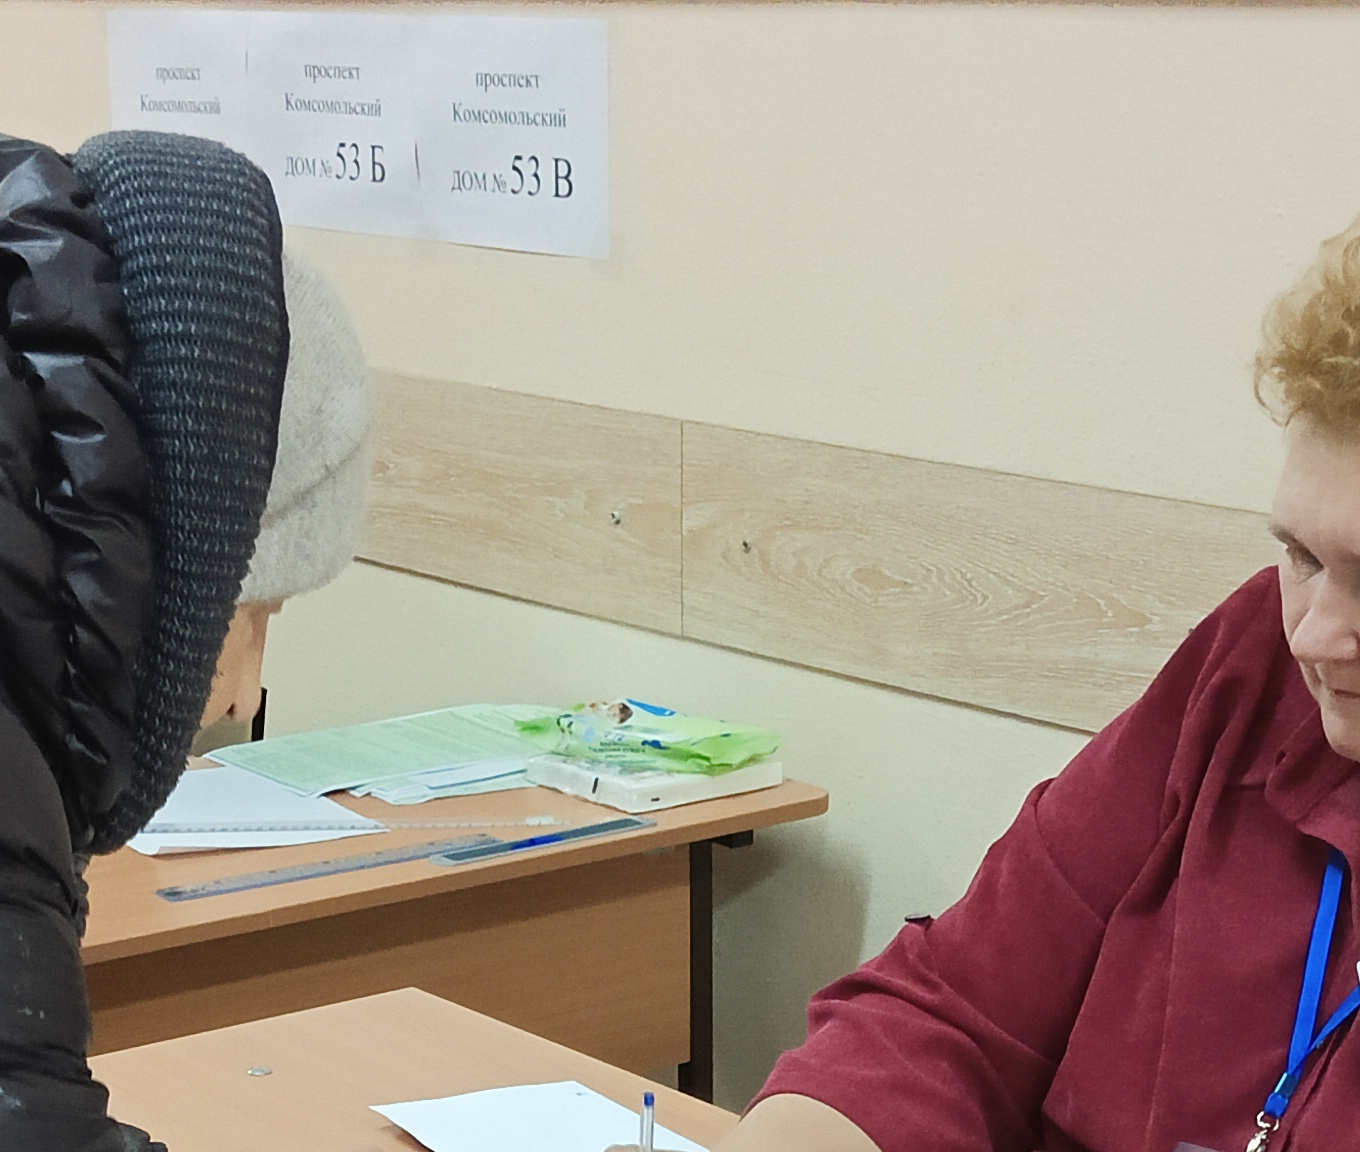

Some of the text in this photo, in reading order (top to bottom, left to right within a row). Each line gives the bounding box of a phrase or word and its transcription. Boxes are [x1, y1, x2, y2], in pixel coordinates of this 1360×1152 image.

[304, 64, 361, 84] проспект
[475, 71, 540, 93] проспект
[284, 92, 382, 118] Комсомольский
[452, 101, 568, 129] Комсомольский
[334, 142, 362, 182] 53
[369, 144, 386, 184] Б
[510, 154, 542, 197] 53
[551, 156, 574, 199] В
